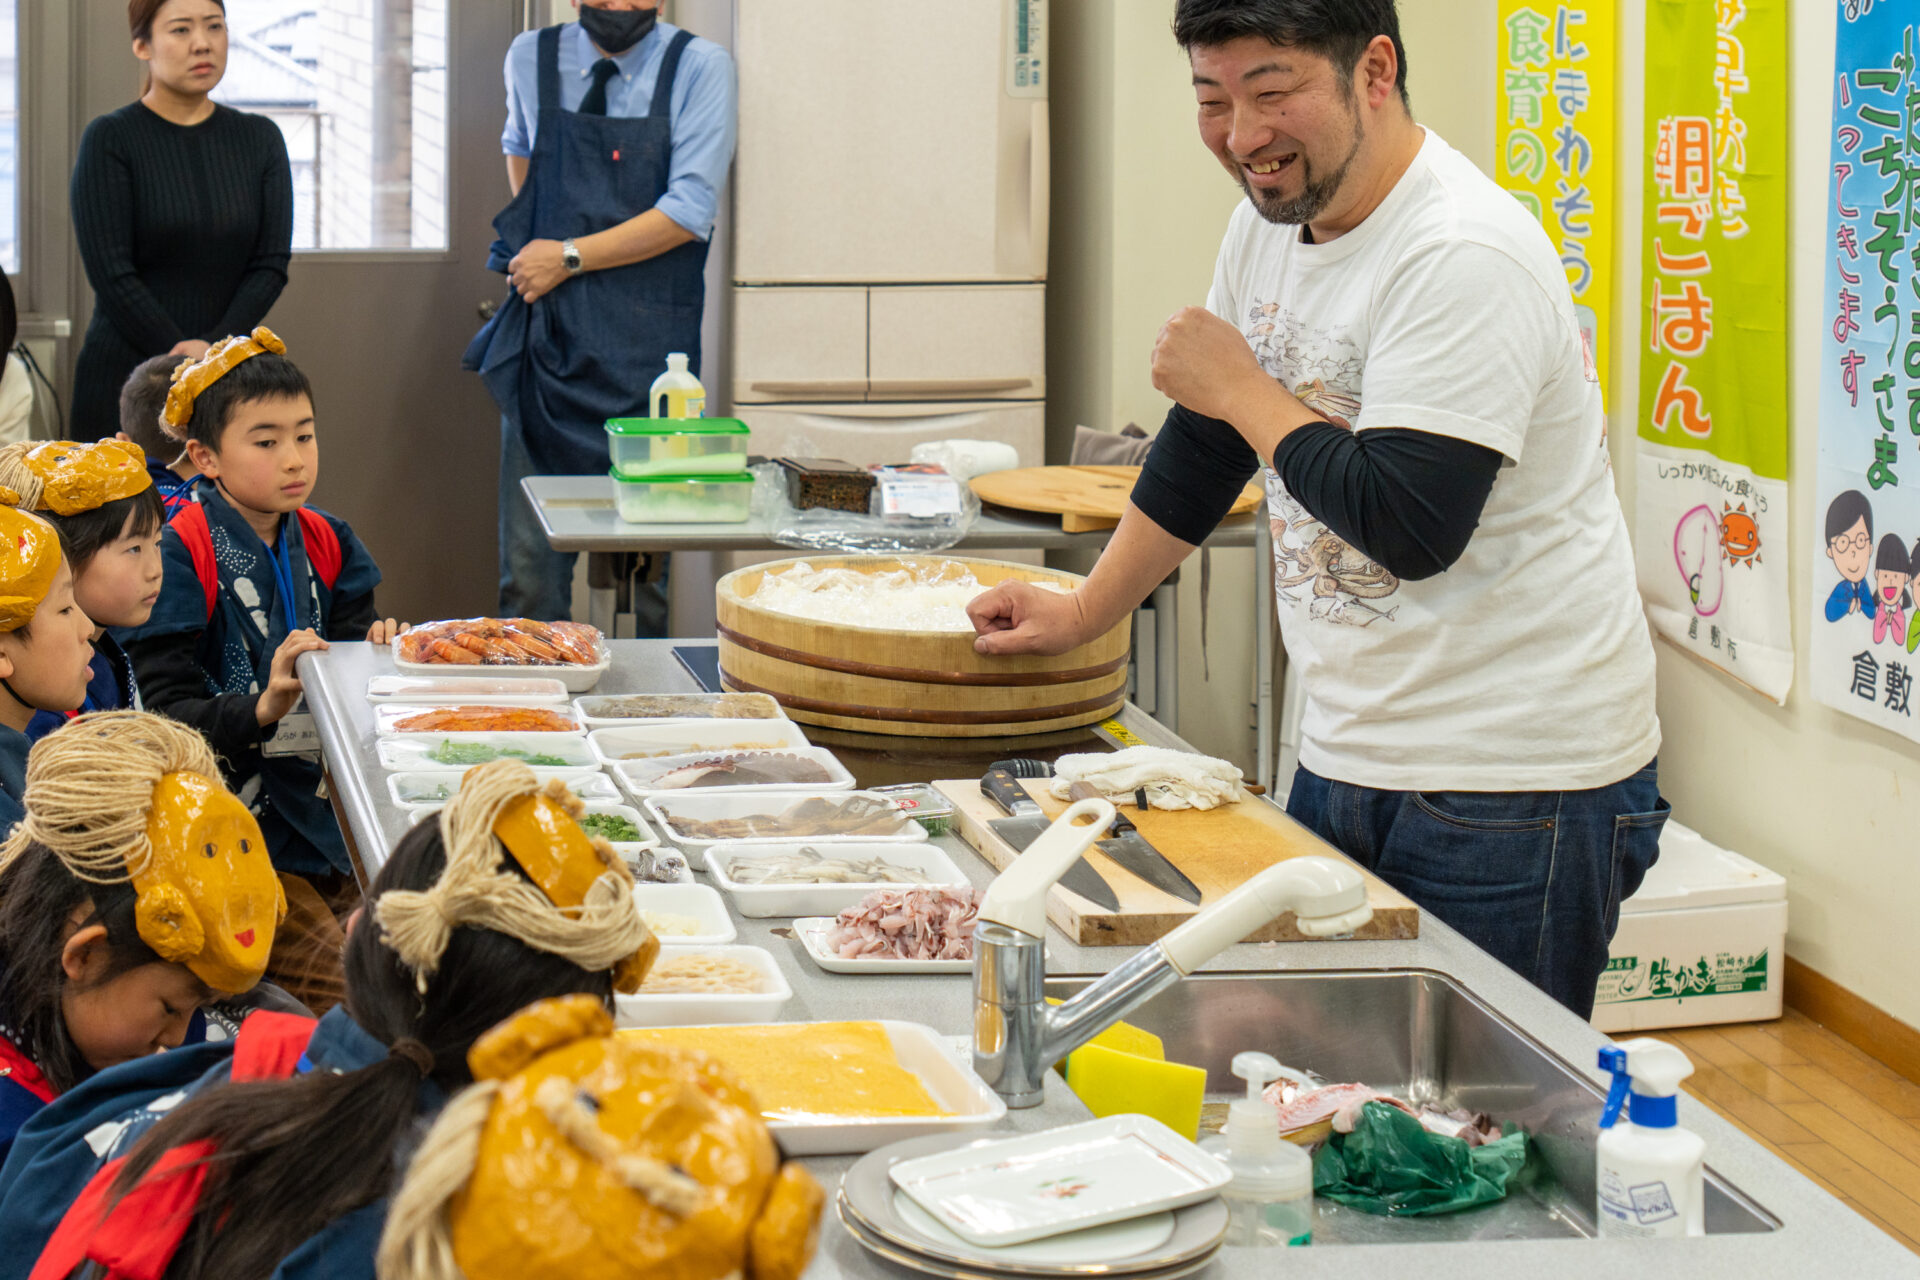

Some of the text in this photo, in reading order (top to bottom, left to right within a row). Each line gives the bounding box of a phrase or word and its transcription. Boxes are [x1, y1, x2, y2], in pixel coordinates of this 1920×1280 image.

[1555, 8, 1591, 293] にまわそう
[1653, 116, 1712, 436] 朝ごはん
[1858, 55, 1906, 490] ごちそうさま
[1850, 650, 1913, 717] 倉敷
